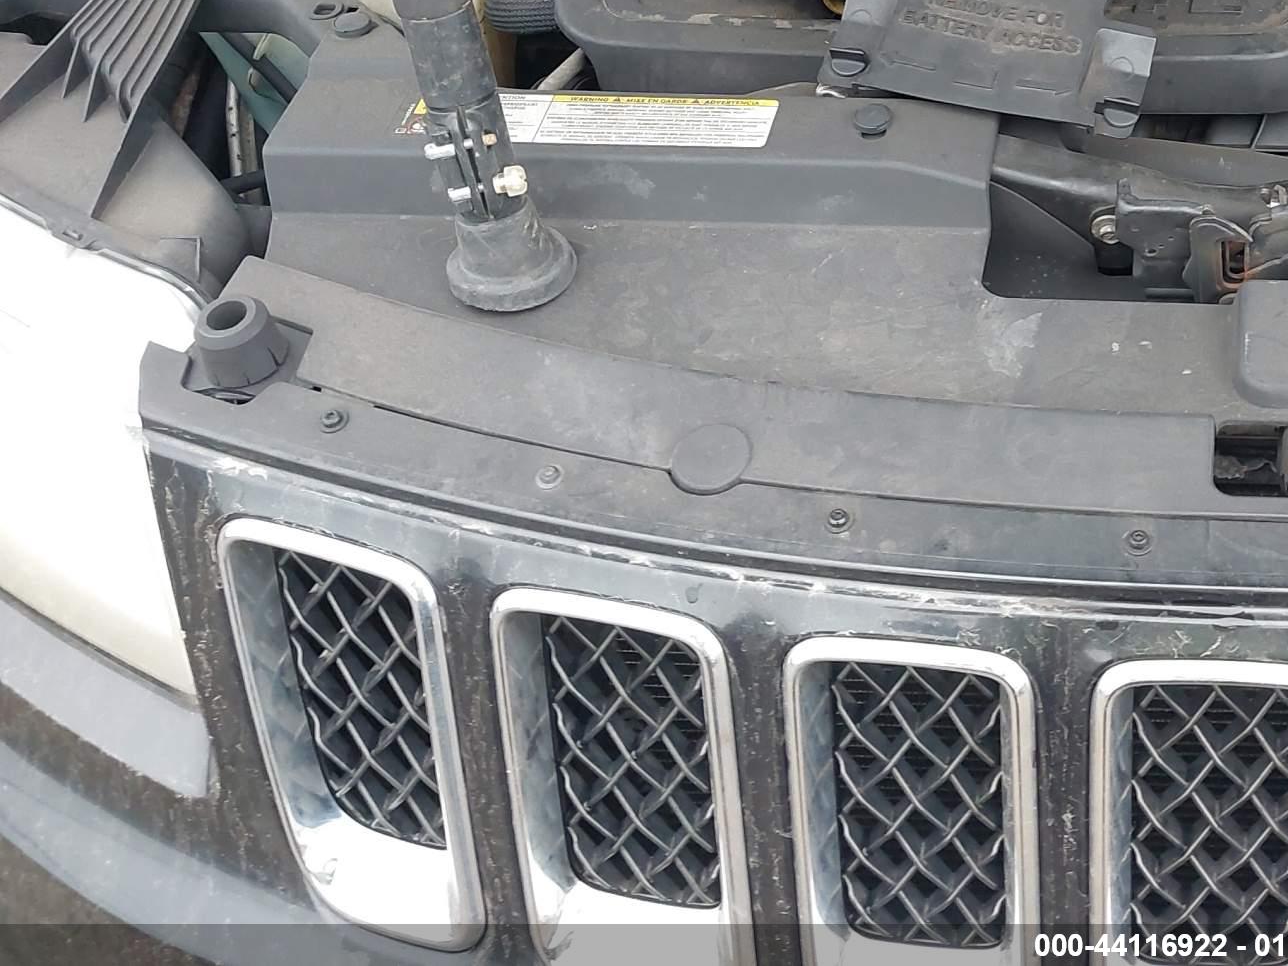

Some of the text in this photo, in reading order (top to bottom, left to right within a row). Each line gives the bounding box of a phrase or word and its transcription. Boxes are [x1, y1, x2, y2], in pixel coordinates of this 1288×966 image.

[902, 9, 1083, 56] BATTERY ACCESS
[1024, 9, 1066, 29] FOR
